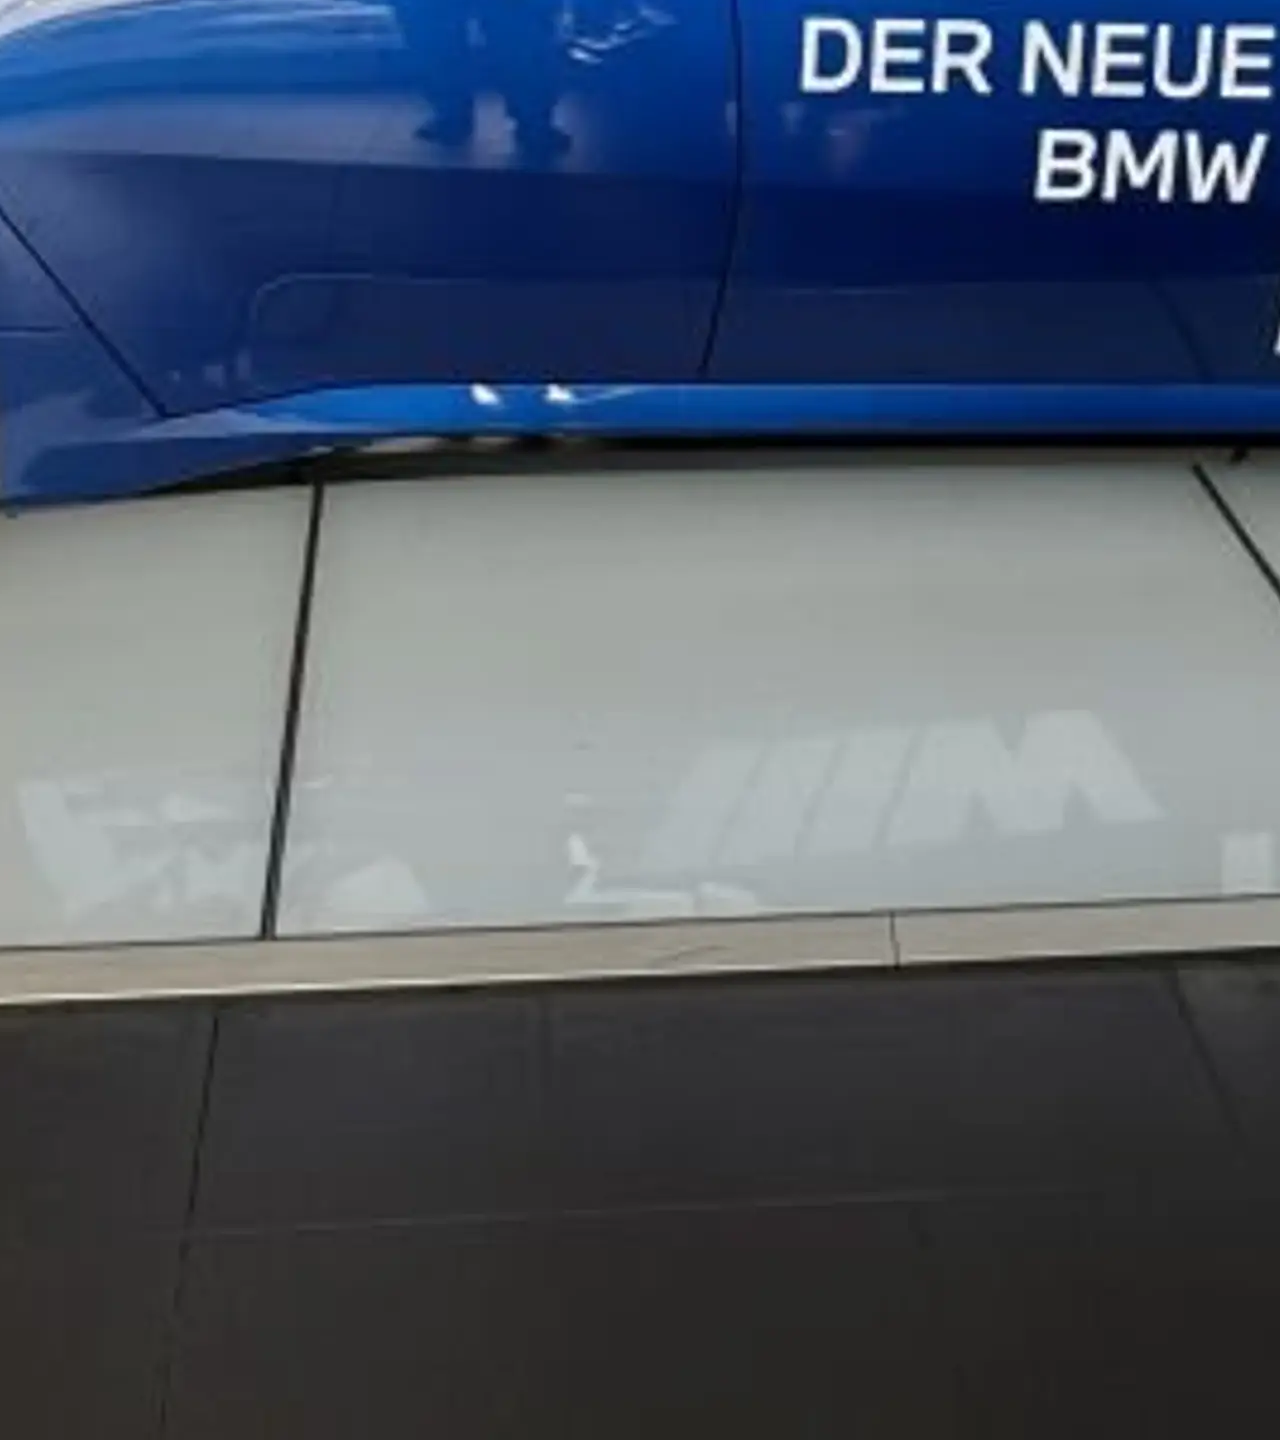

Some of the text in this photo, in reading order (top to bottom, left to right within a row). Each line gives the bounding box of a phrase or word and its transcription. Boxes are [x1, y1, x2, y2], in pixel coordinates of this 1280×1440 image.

[802, 18, 1276, 98] DER NEUE
[1035, 129, 1268, 202] BMW
